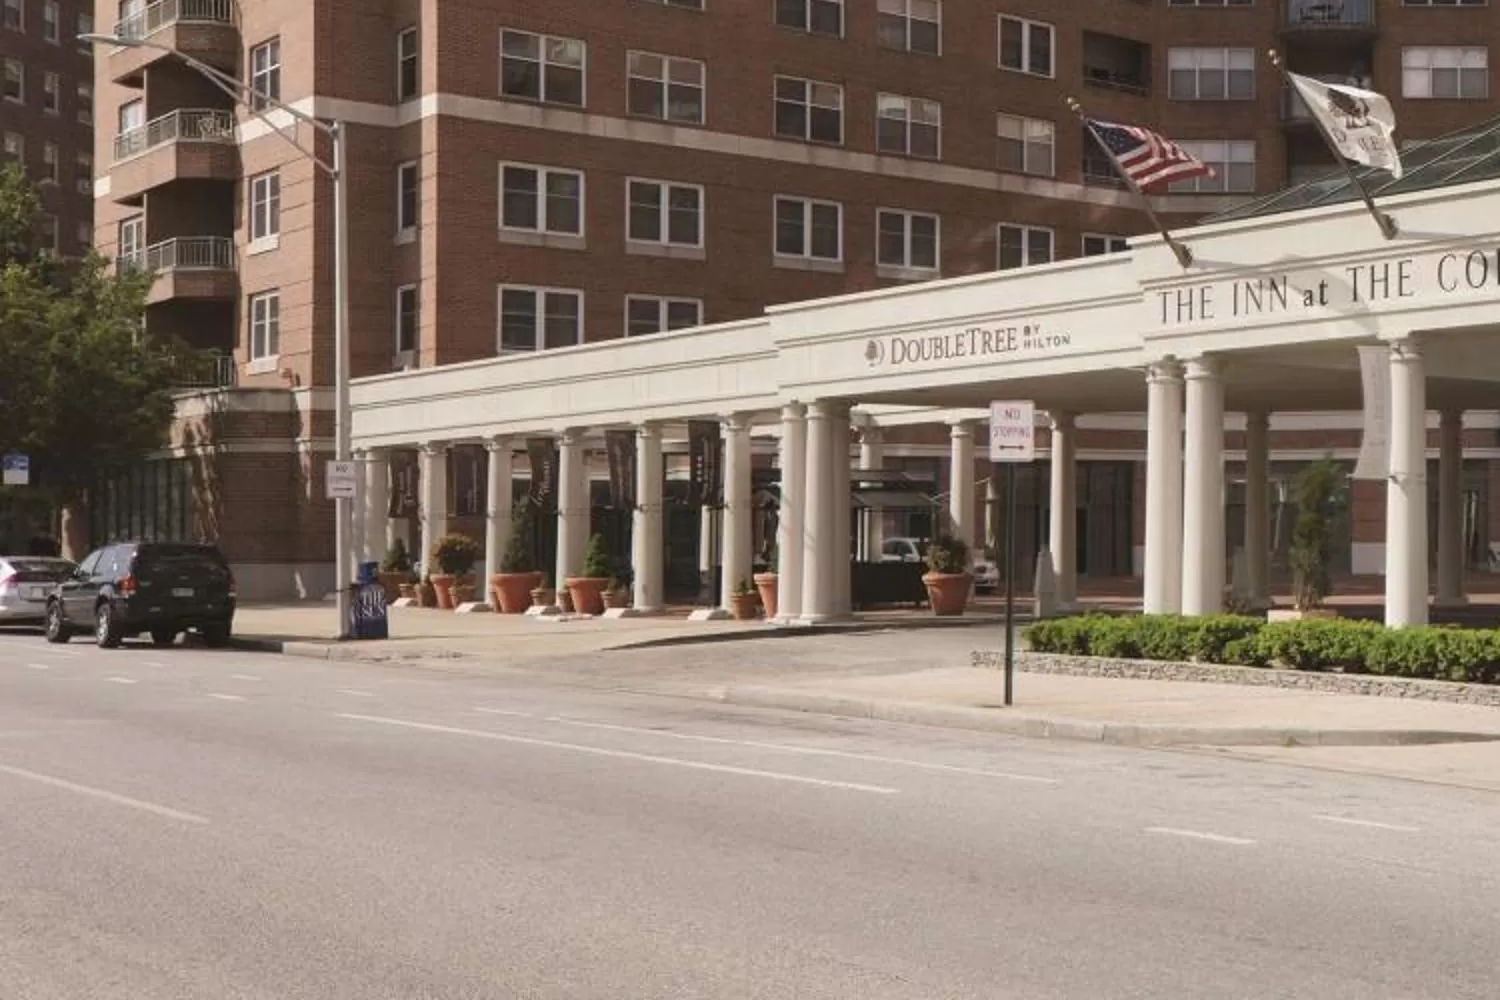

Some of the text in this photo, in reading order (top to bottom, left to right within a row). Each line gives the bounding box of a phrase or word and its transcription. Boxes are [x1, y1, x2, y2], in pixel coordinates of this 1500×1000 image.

[1157, 286, 1214, 325] THE
[1232, 275, 1288, 317] INN
[1303, 279, 1329, 307] at
[1346, 259, 1414, 303] THE
[1023, 324, 1041, 337] BY
[1023, 335, 1071, 349] HILTON
[1005, 408, 1021, 420] NO
